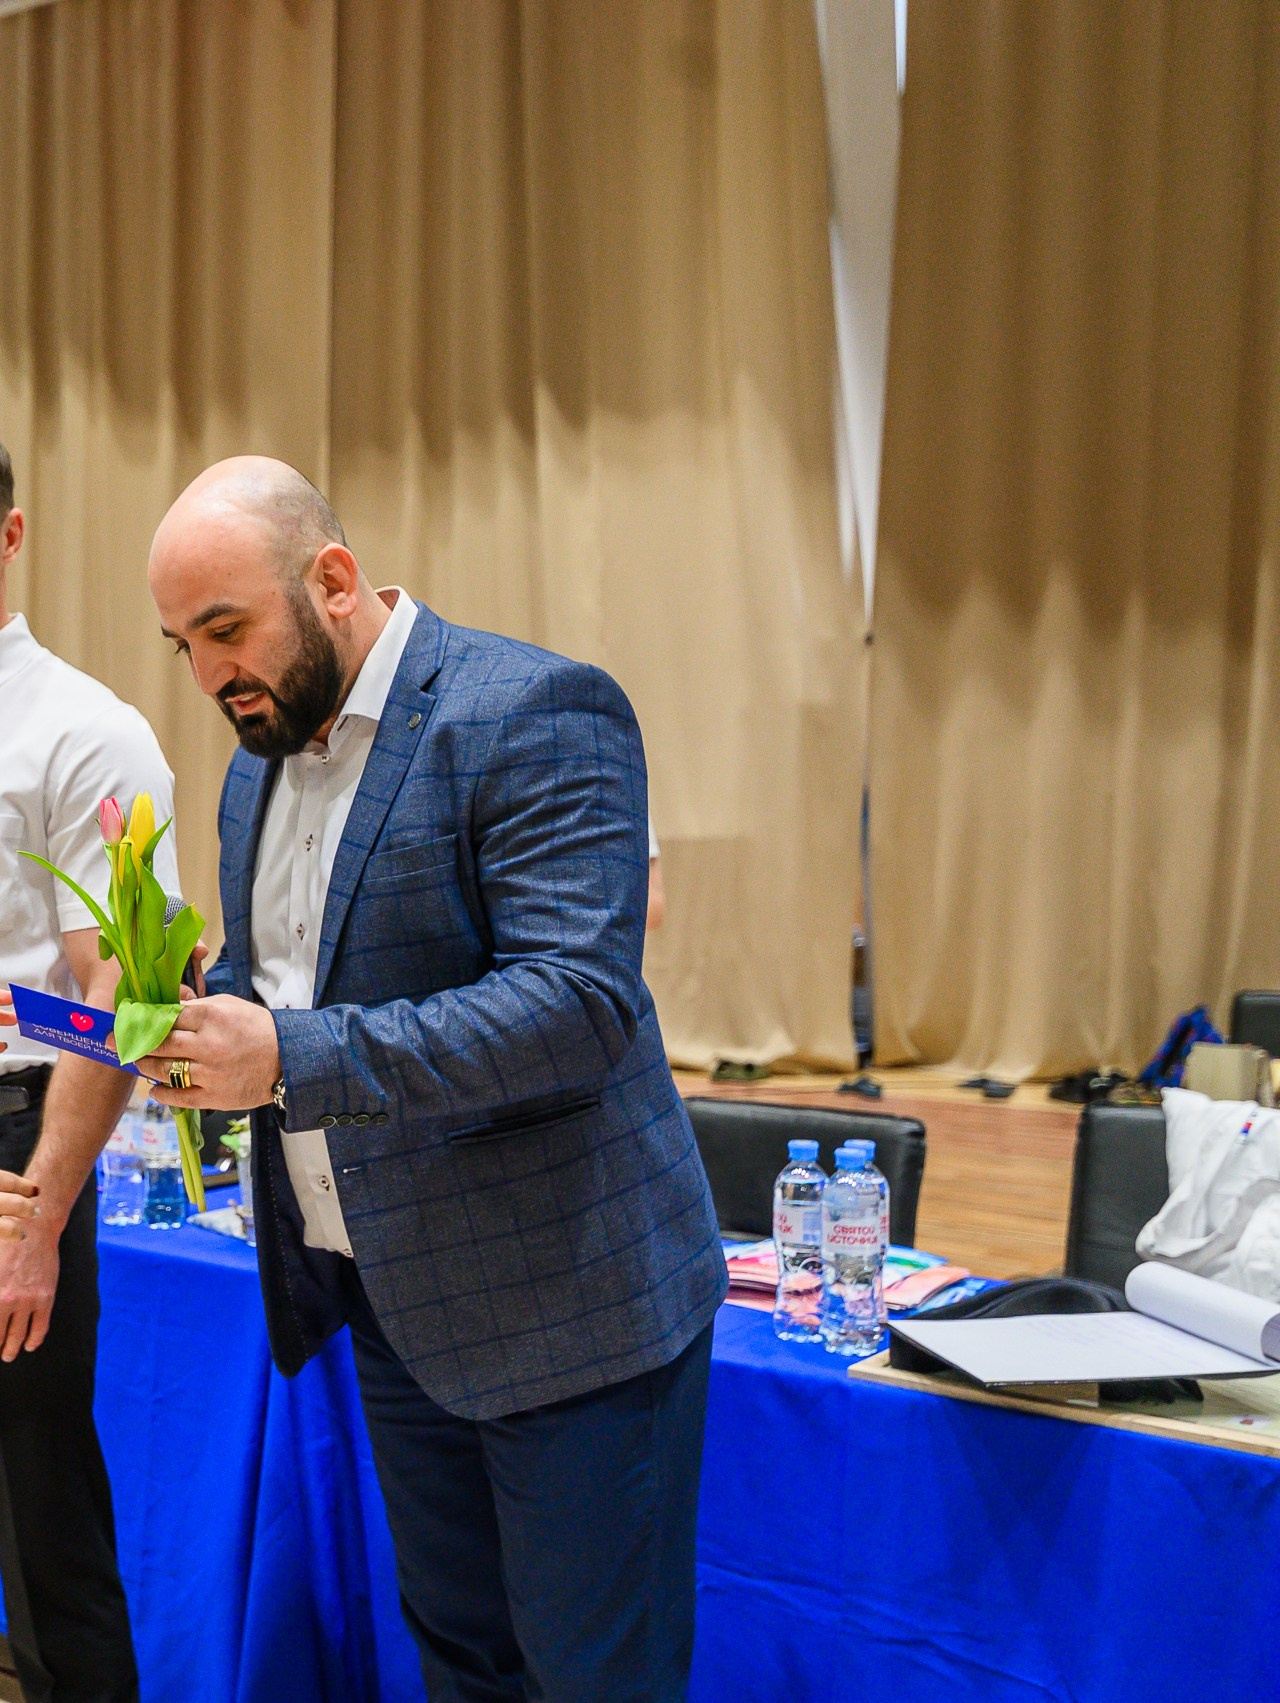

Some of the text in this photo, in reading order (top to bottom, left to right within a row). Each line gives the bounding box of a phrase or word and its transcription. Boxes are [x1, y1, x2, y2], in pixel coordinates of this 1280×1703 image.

[33, 1028, 120, 1060] ДЛЯ ТВОЕЙ КРАС
